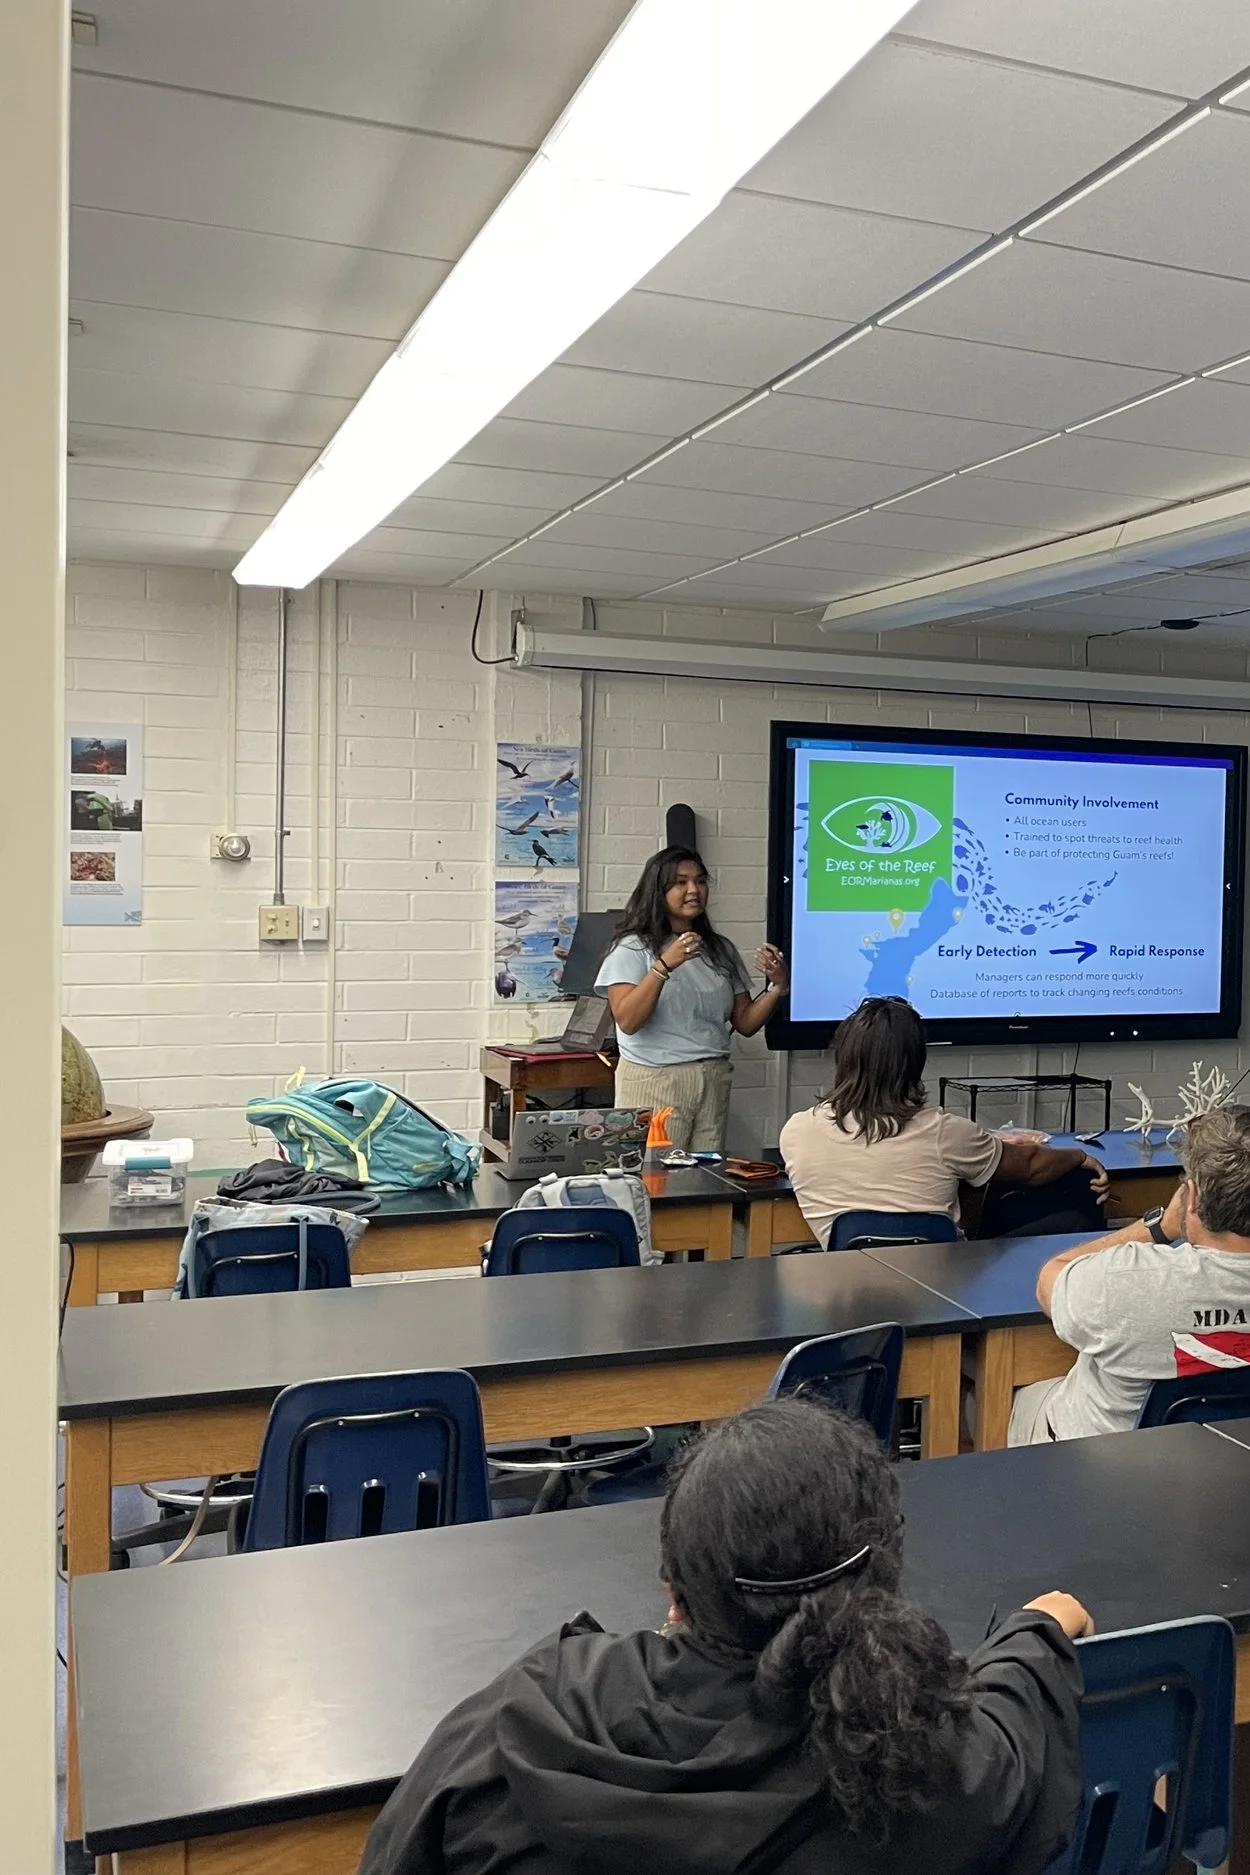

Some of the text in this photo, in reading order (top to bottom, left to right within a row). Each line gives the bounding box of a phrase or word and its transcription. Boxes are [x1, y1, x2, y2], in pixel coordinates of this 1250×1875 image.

[1005, 792, 1159, 810] Community Involvement
[1014, 816, 1087, 827] All ocean users
[1014, 831, 1183, 845] Trained to spot threats to reef health
[1013, 848, 1174, 860] Be part of protecting Guam's reefs!
[825, 858, 937, 873] Eyes of the Reef
[841, 876, 920, 887] EORMarianas.org
[938, 944, 1205, 960] Early Detection Rapid Response
[975, 972, 1144, 983] Managers can respond more quickly
[930, 986, 1183, 1000] Database of reports to track changing reefs conditions
[1193, 1309, 1247, 1327] MDA
